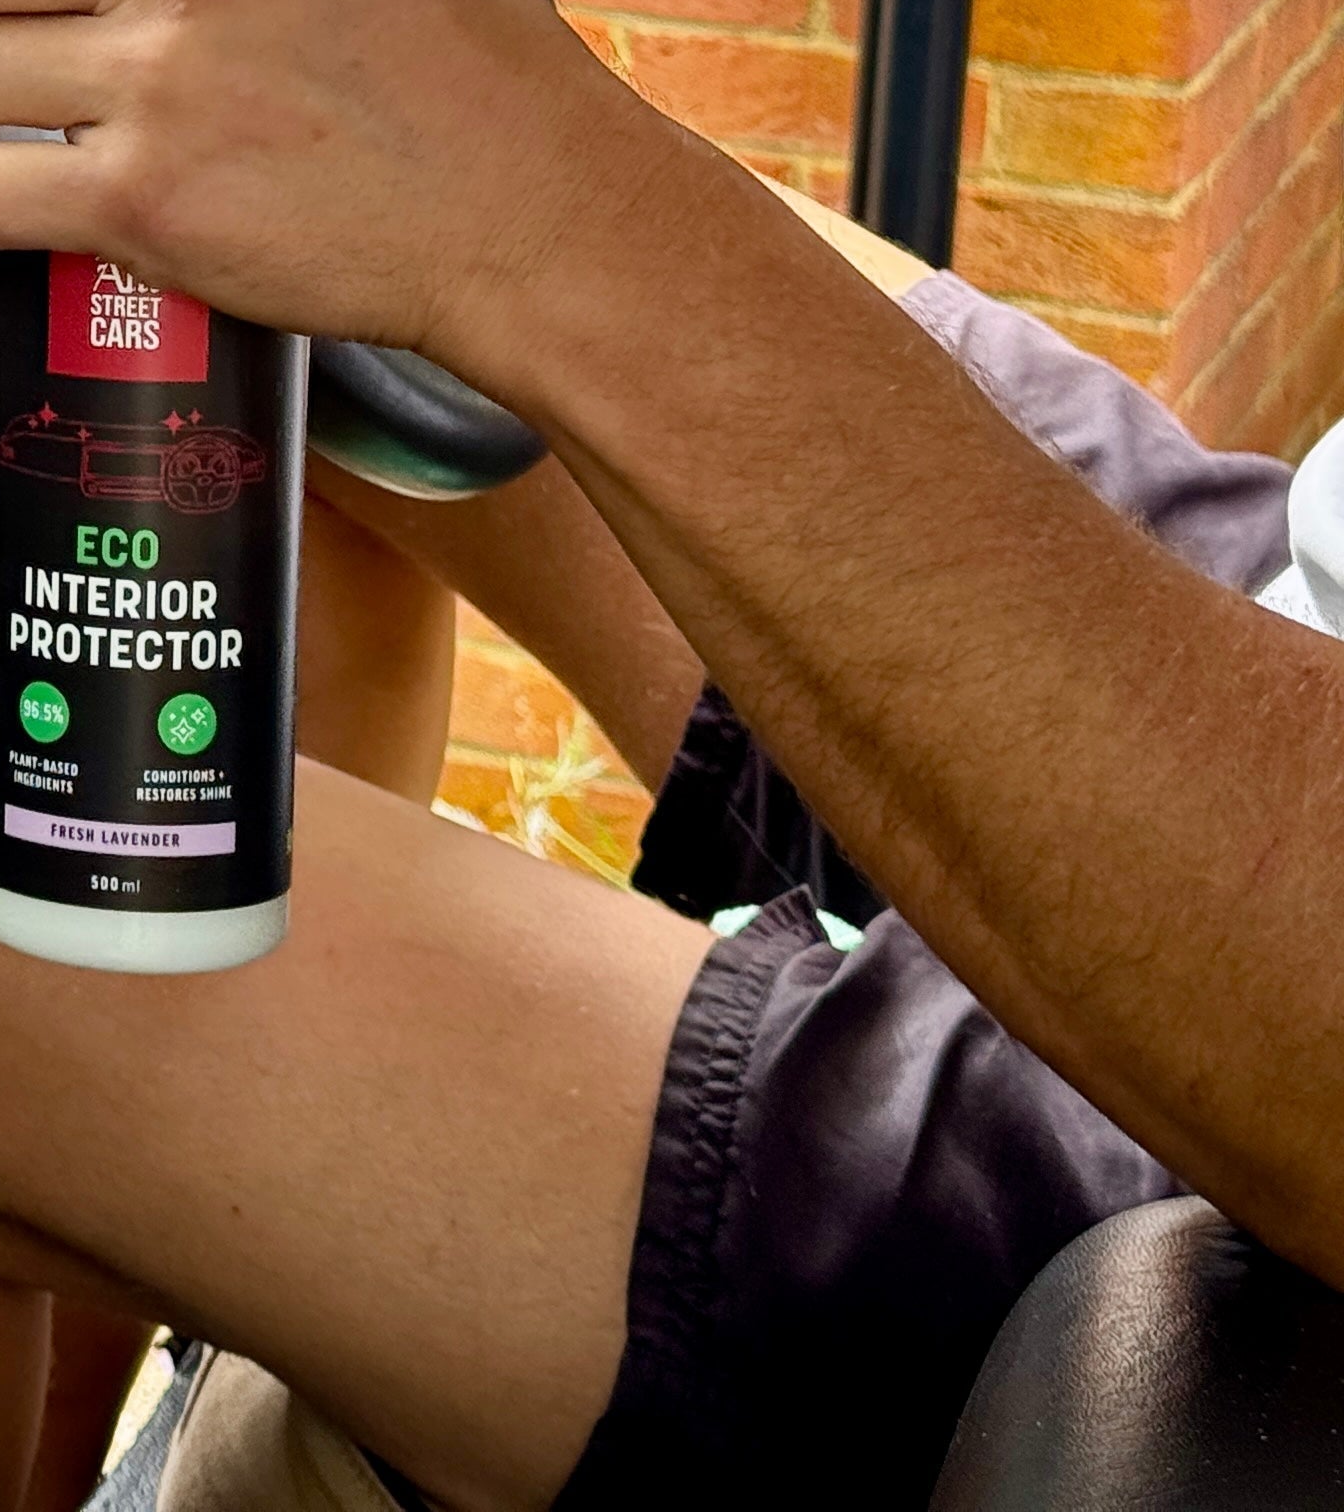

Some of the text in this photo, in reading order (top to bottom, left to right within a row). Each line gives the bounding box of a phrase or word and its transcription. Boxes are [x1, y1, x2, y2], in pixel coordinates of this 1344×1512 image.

[90, 293, 163, 319] STREET
[90, 316, 160, 351] CARS
[76, 525, 159, 569] ECO
[24, 565, 218, 621] INTERIOR
[10, 612, 243, 671] PROTECTOR
[9, 750, 79, 777] PLANT-BASED
[143, 769, 216, 784] CONDITIONS
[136, 785, 232, 802] RESTORES SHINE
[50, 823, 180, 847] FRESH LAVENDER
